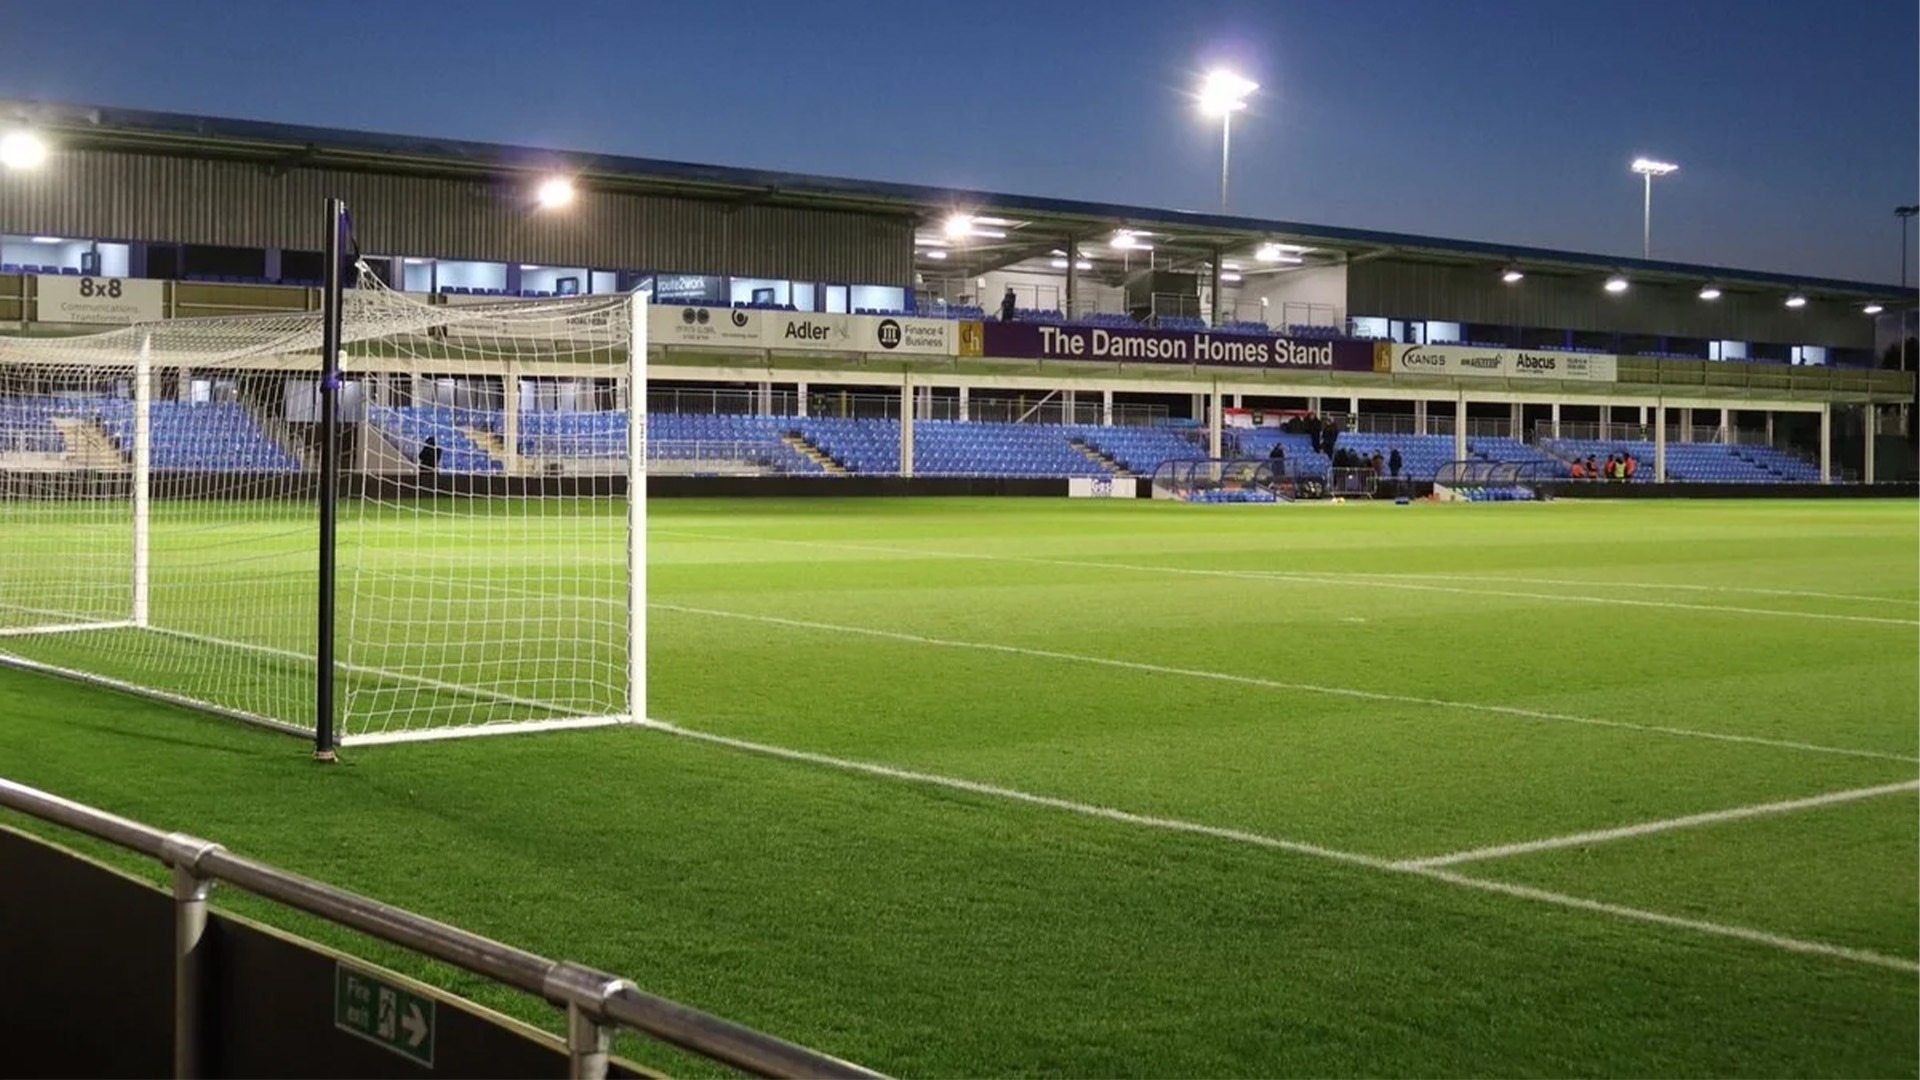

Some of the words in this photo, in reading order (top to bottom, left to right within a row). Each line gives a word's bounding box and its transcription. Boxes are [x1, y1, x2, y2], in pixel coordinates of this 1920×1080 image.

[80, 277, 122, 298] 8x8
[785, 321, 831, 340] Adler
[905, 324, 936, 336] Finance
[937, 326, 944, 336] 4
[905, 336, 943, 347] Business
[1039, 326, 1084, 355] The
[1092, 329, 1186, 359] Damson
[1194, 334, 1269, 363] Homes
[1275, 339, 1333, 366] Stand
[1407, 354, 1446, 366] KANGS
[1516, 353, 1556, 369] Abacus
[347, 976, 371, 1002] Fire
[347, 1004, 370, 1029] exit
